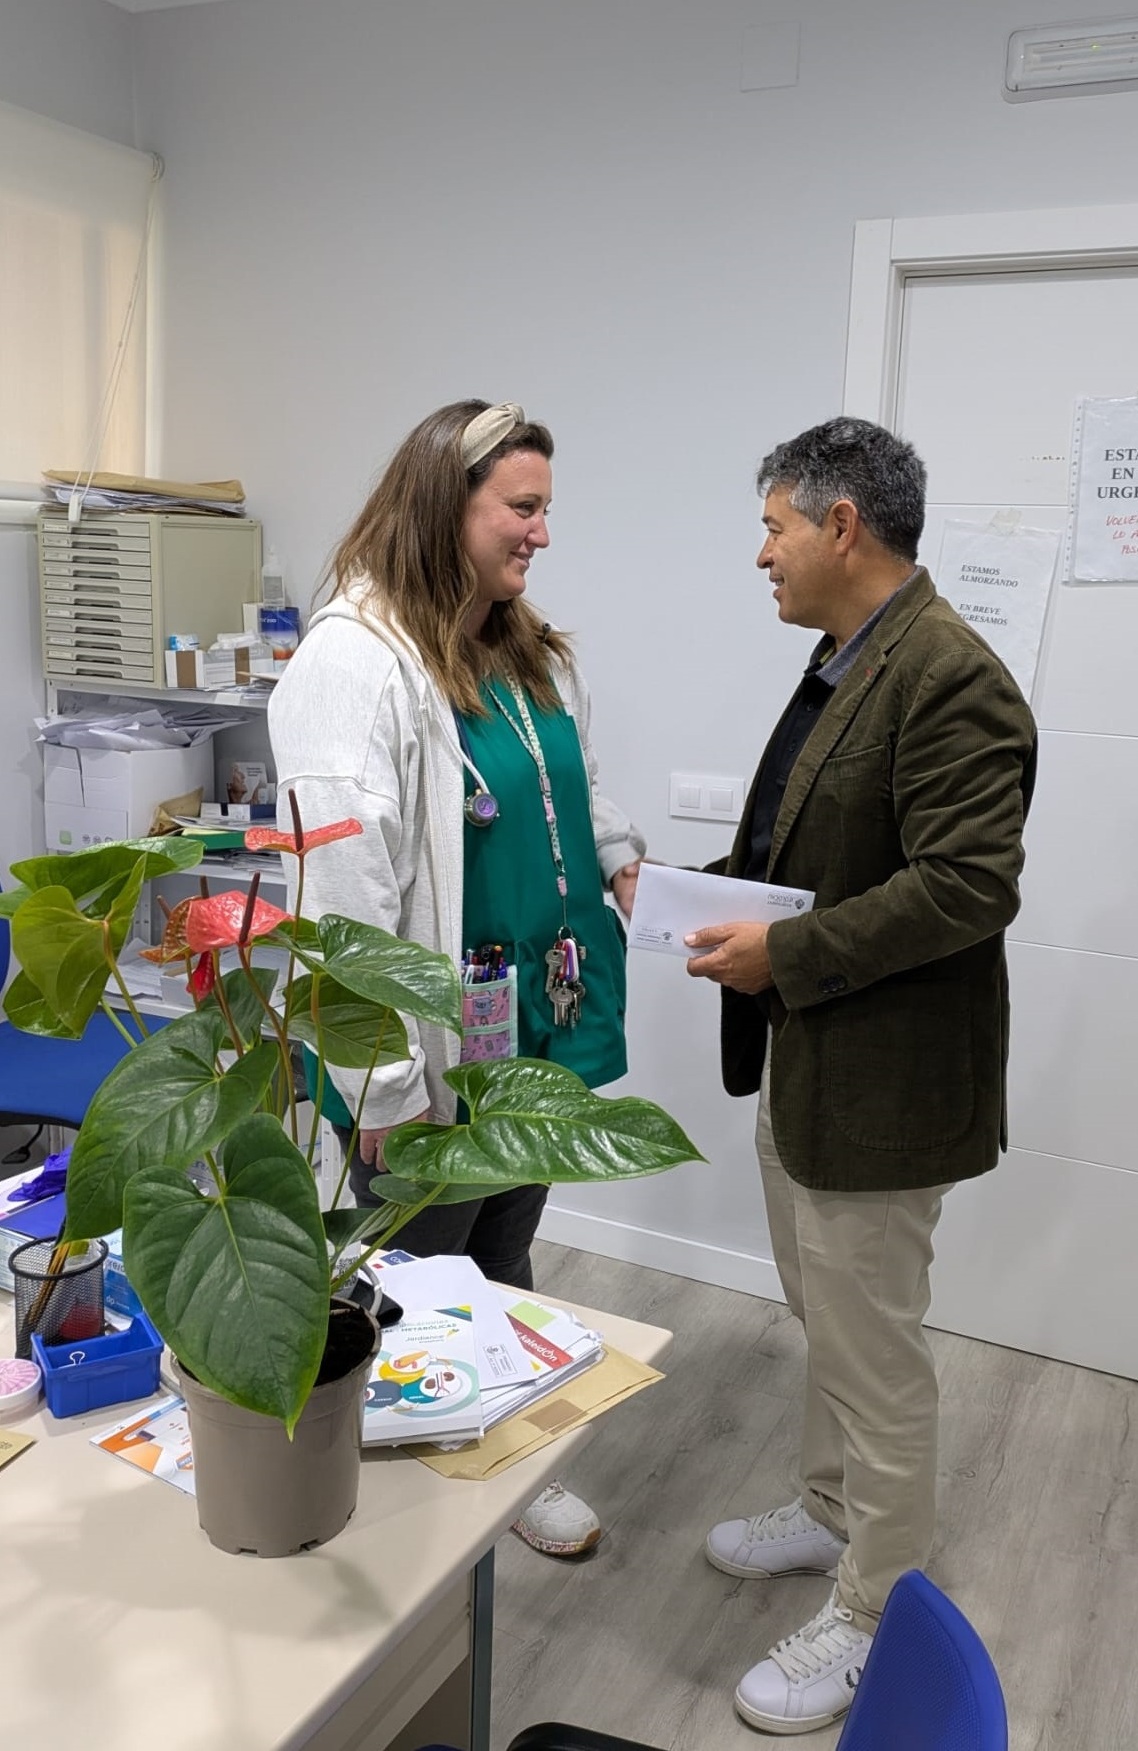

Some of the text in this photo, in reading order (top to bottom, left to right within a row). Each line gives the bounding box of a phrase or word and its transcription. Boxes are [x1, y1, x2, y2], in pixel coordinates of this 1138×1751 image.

[1104, 448, 1138, 462] EST
[1111, 467, 1134, 480] EN
[1105, 514, 1138, 526] VOLVE
[961, 564, 1001, 576] ESTAMOS
[959, 574, 1019, 588] ALMORZANDO
[960, 603, 1001, 615] EN BREVE
